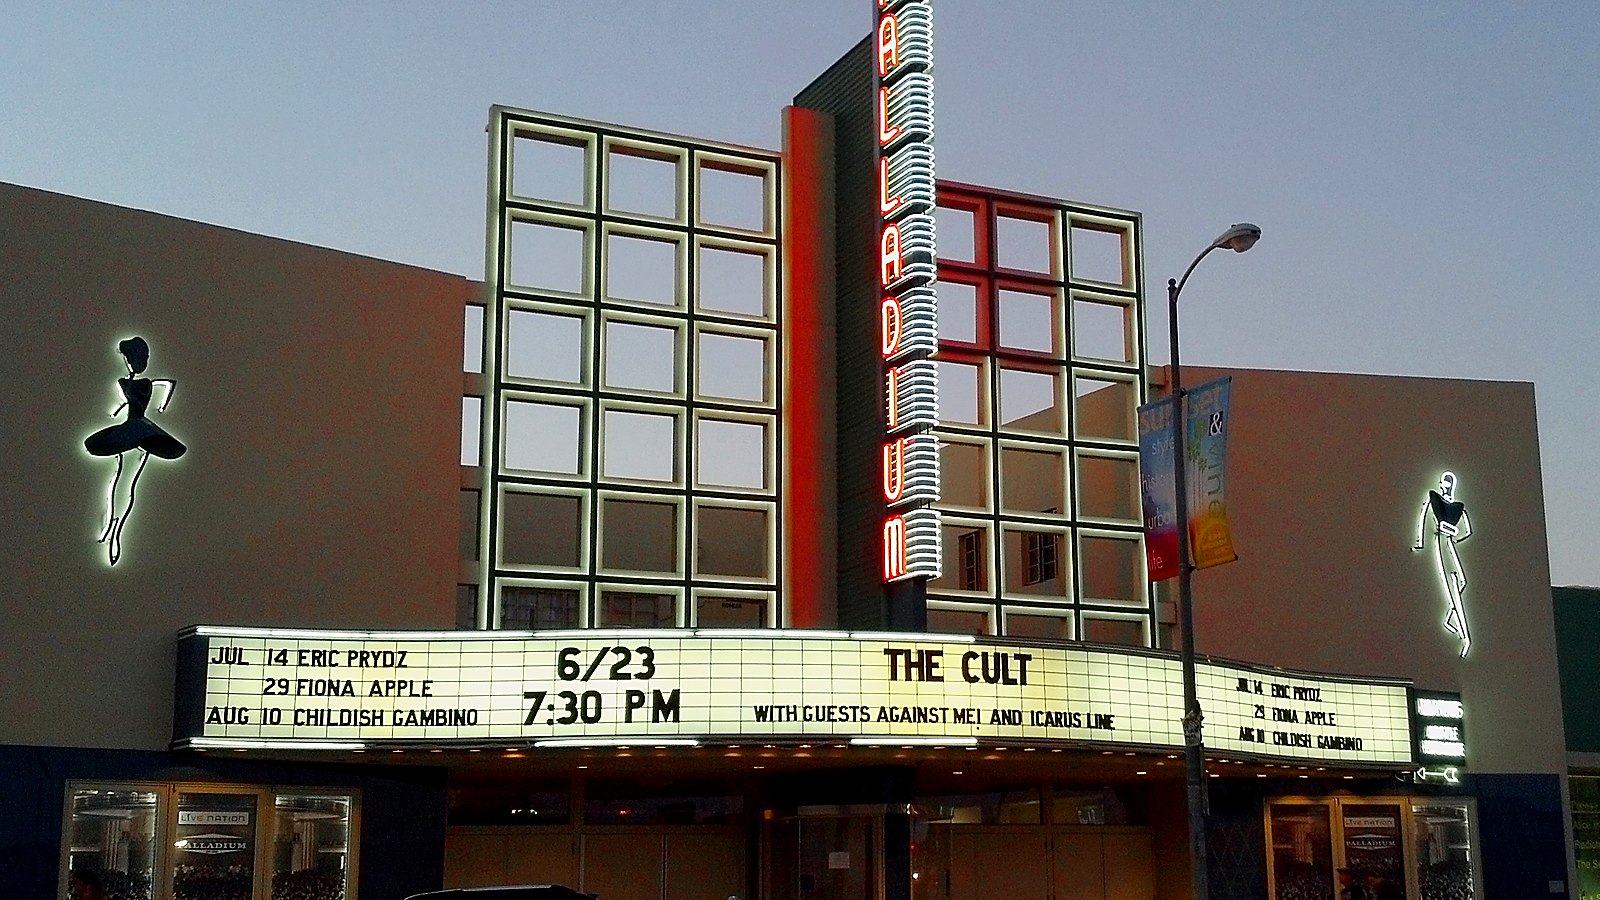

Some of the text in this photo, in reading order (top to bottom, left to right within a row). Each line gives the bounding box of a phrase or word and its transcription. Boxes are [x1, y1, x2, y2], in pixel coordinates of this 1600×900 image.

[879, 0, 906, 582] ALLADIUM
[211, 647, 408, 668] JUL 14 ERIC PRYDZ
[557, 646, 655, 682] 6/23
[884, 648, 1032, 686] THE CULT
[263, 678, 433, 698] 29 FIONA APPLE
[1253, 679, 1264, 695] 14
[1271, 683, 1290, 699] ERIC
[205, 706, 478, 727] AUG 10 CHILDISH GAMBINO
[523, 689, 680, 726] 7:30 PM
[753, 705, 1115, 730] WITH GUESTS AGAINST ME! AND ICARUS LINE
[1254, 704, 1337, 727] 29 FIONA APPLE
[1272, 732, 1312, 748] CHILDISH
[1317, 735, 1363, 751] GAMBINO
